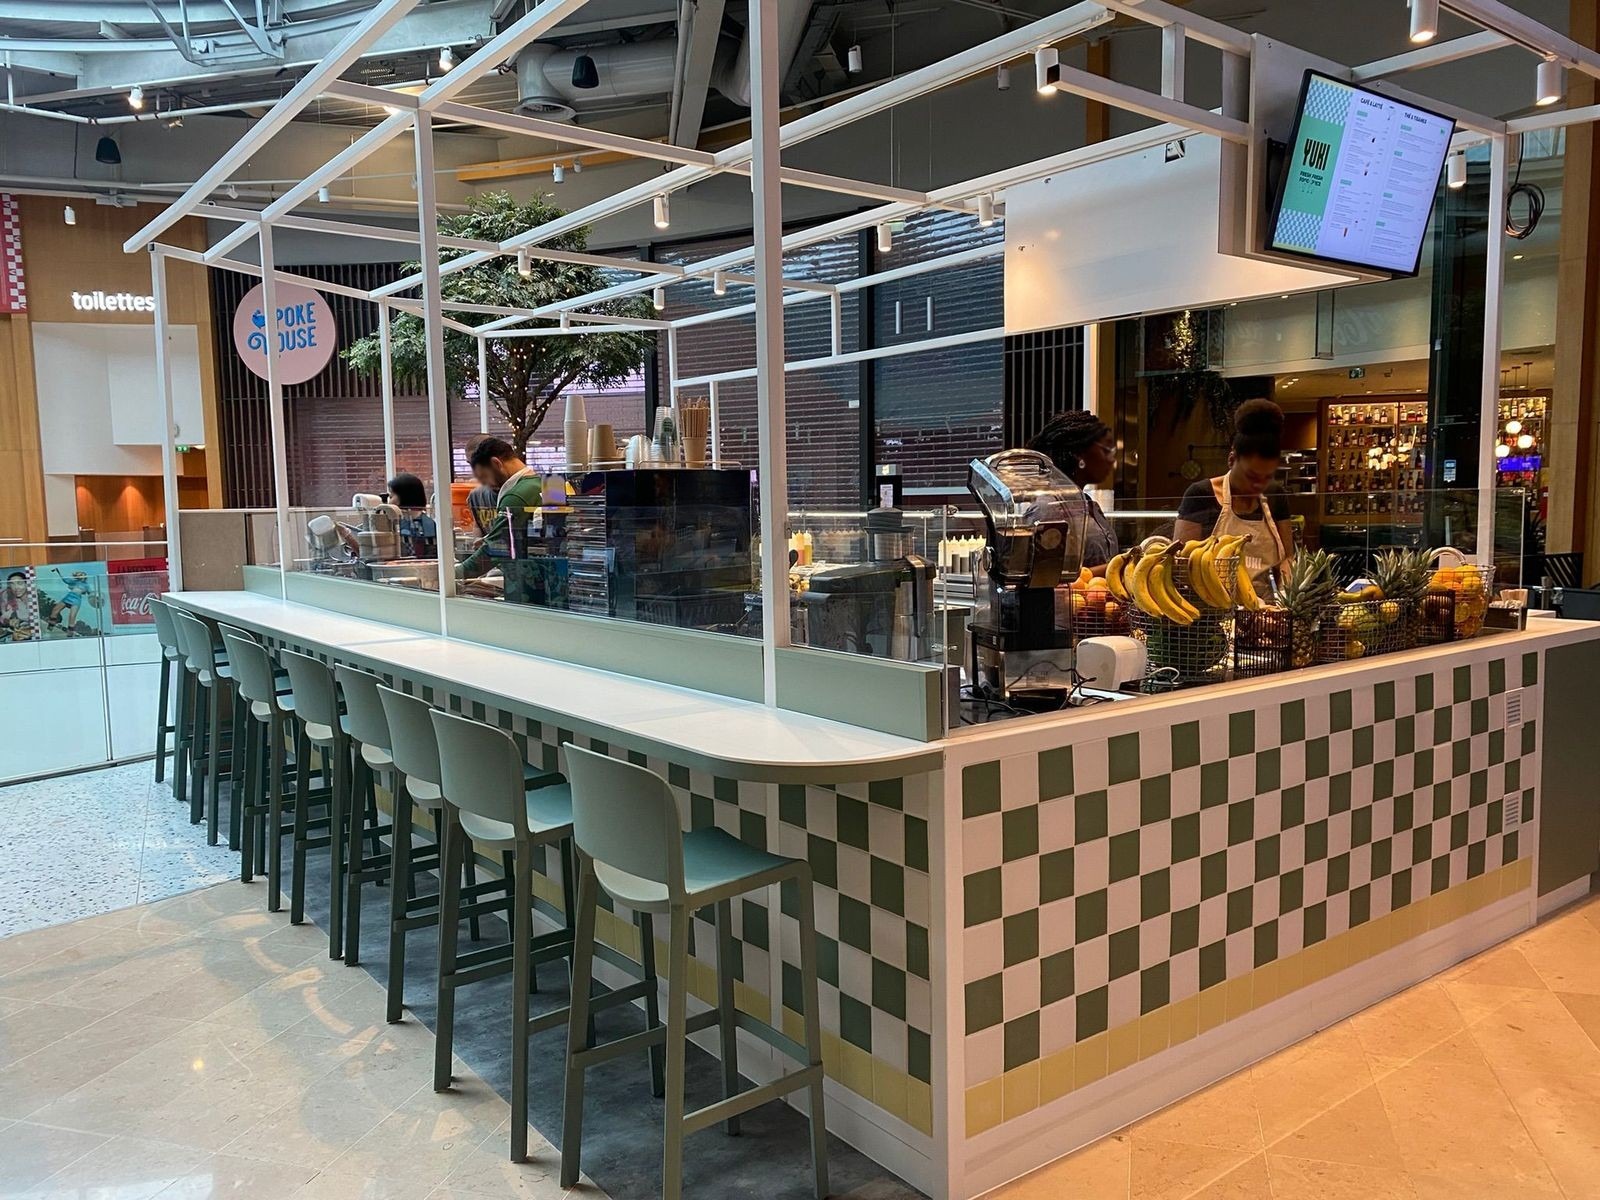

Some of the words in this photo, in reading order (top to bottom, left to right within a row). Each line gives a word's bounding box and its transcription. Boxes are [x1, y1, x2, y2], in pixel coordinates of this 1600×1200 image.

[1302, 138, 1331, 171] YUKI
[71, 290, 156, 311] toilettes
[276, 302, 316, 328] POKE
